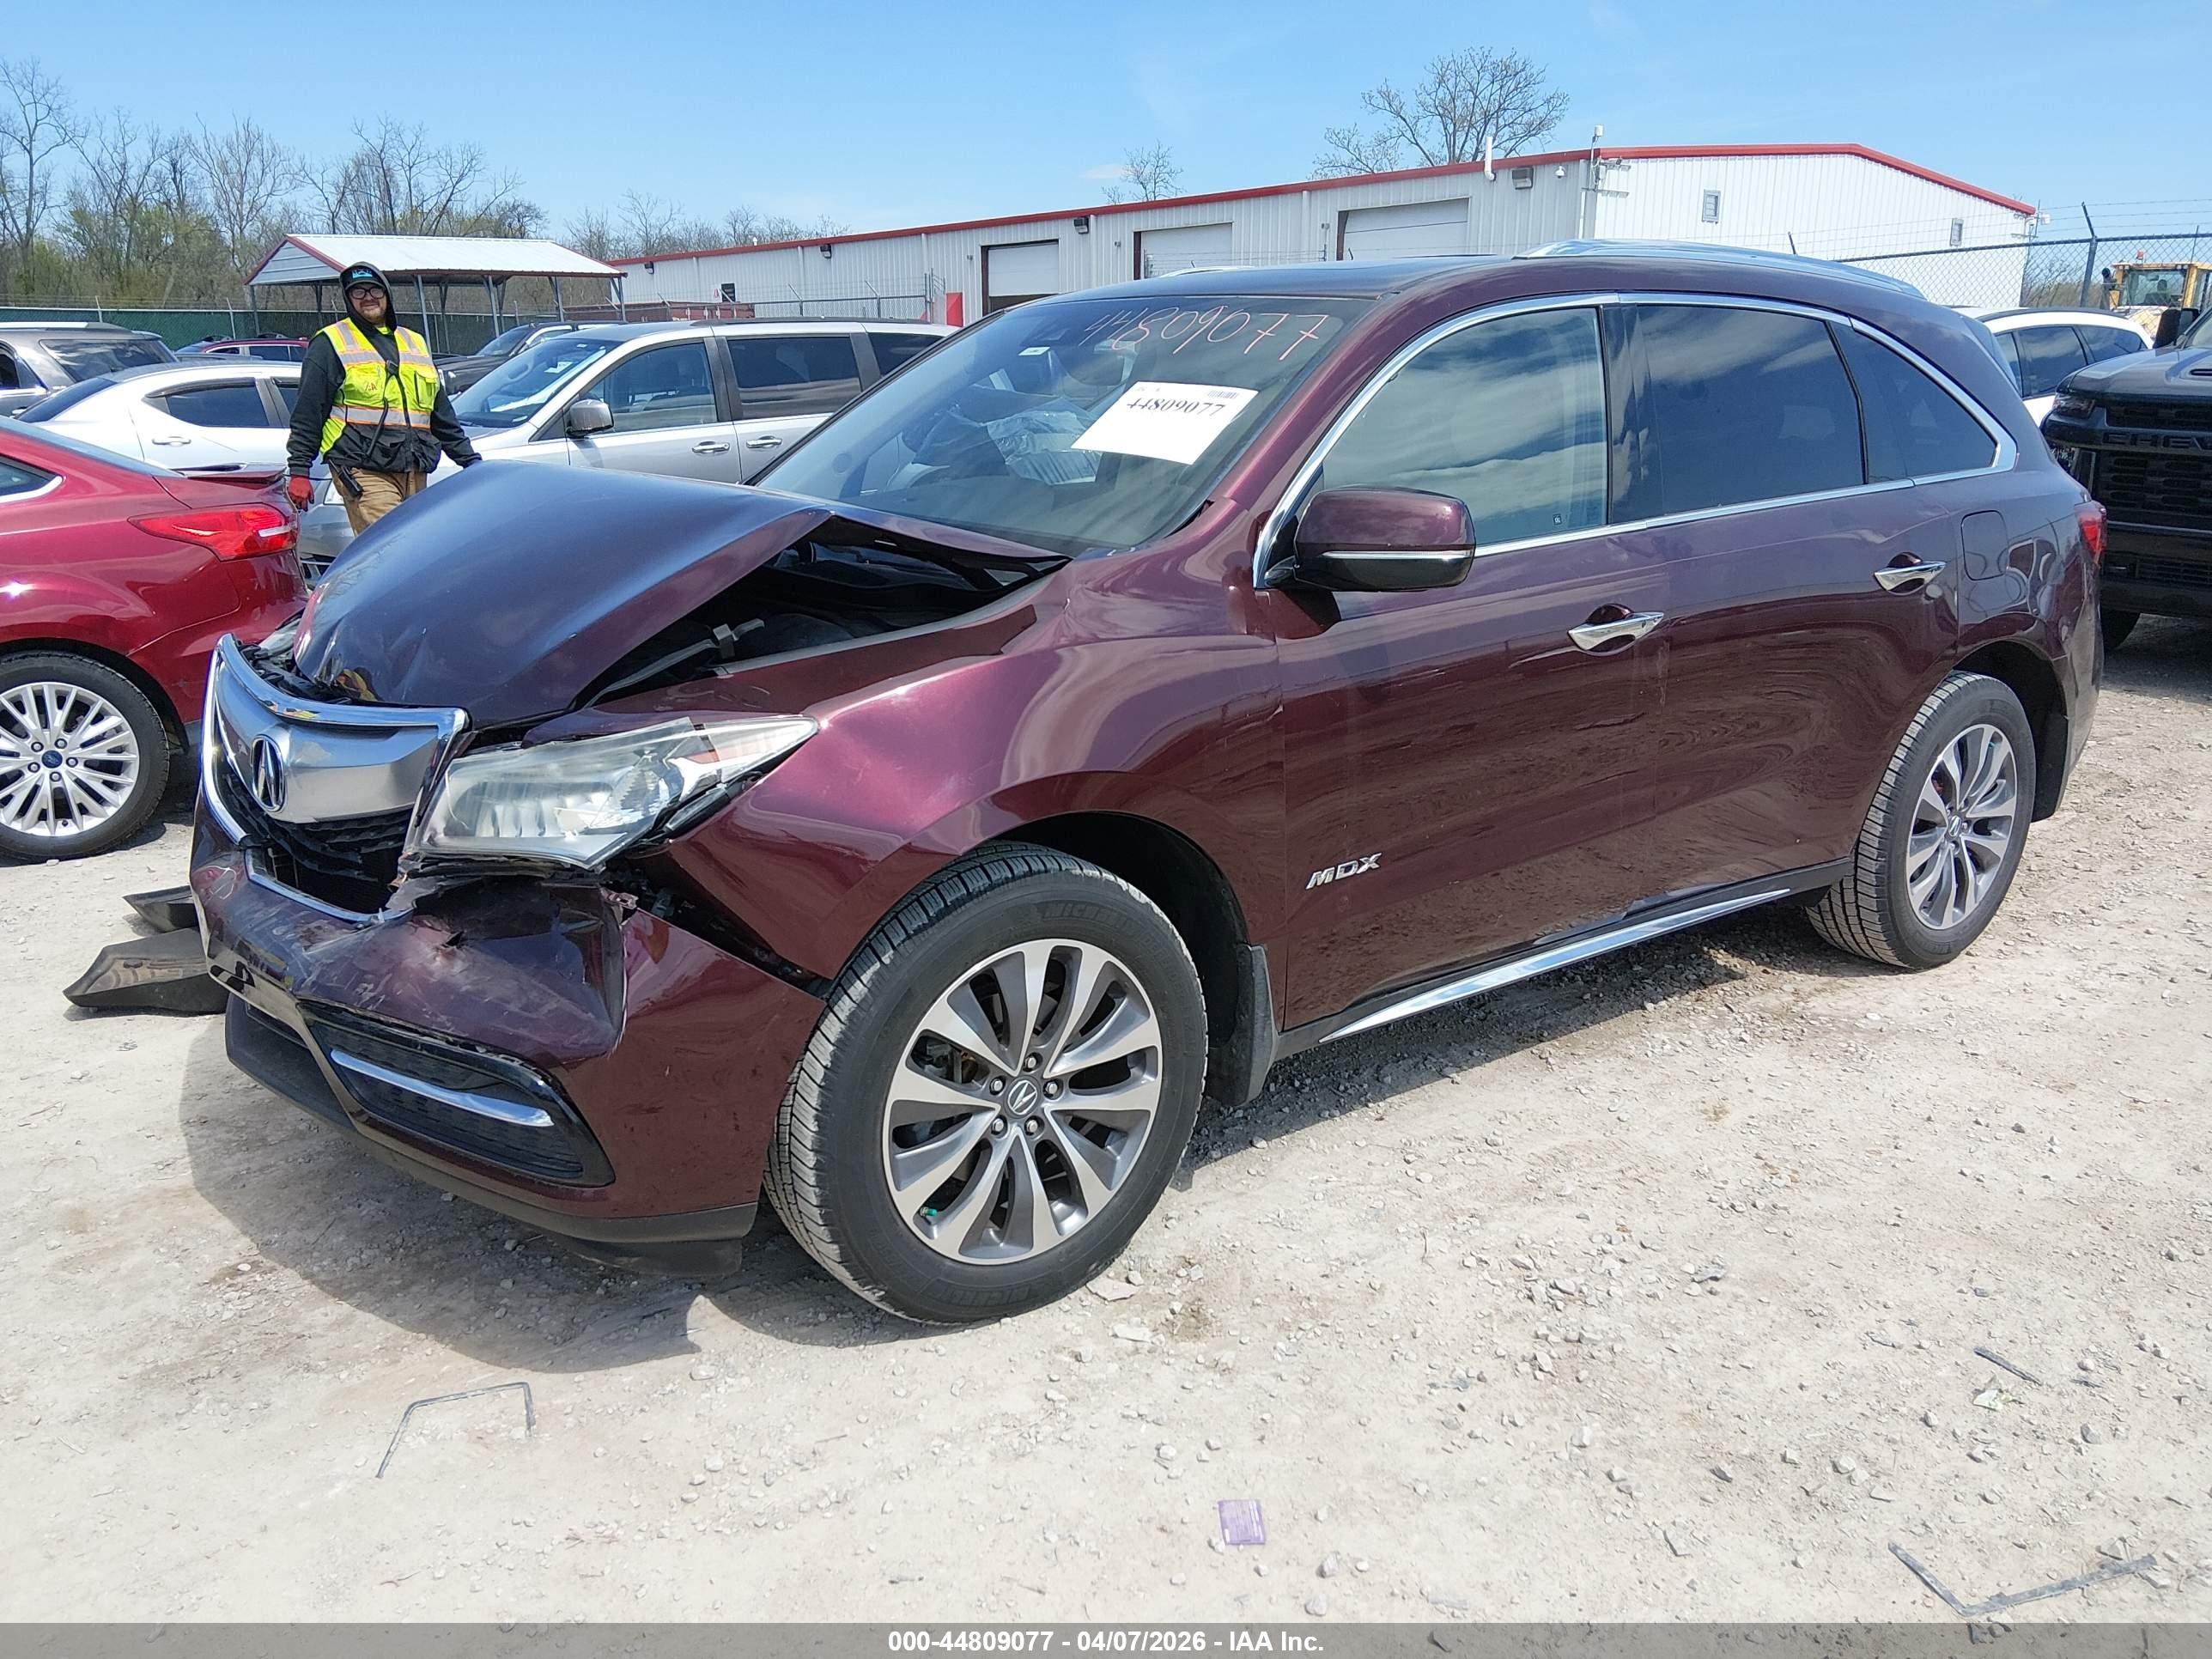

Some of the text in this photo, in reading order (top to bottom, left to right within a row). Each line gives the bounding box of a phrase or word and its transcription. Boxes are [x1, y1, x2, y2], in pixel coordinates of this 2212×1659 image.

[1078, 305, 1329, 361] 44809077
[1127, 397, 1226, 416] 44809077
[1305, 852, 1382, 890] MDX
